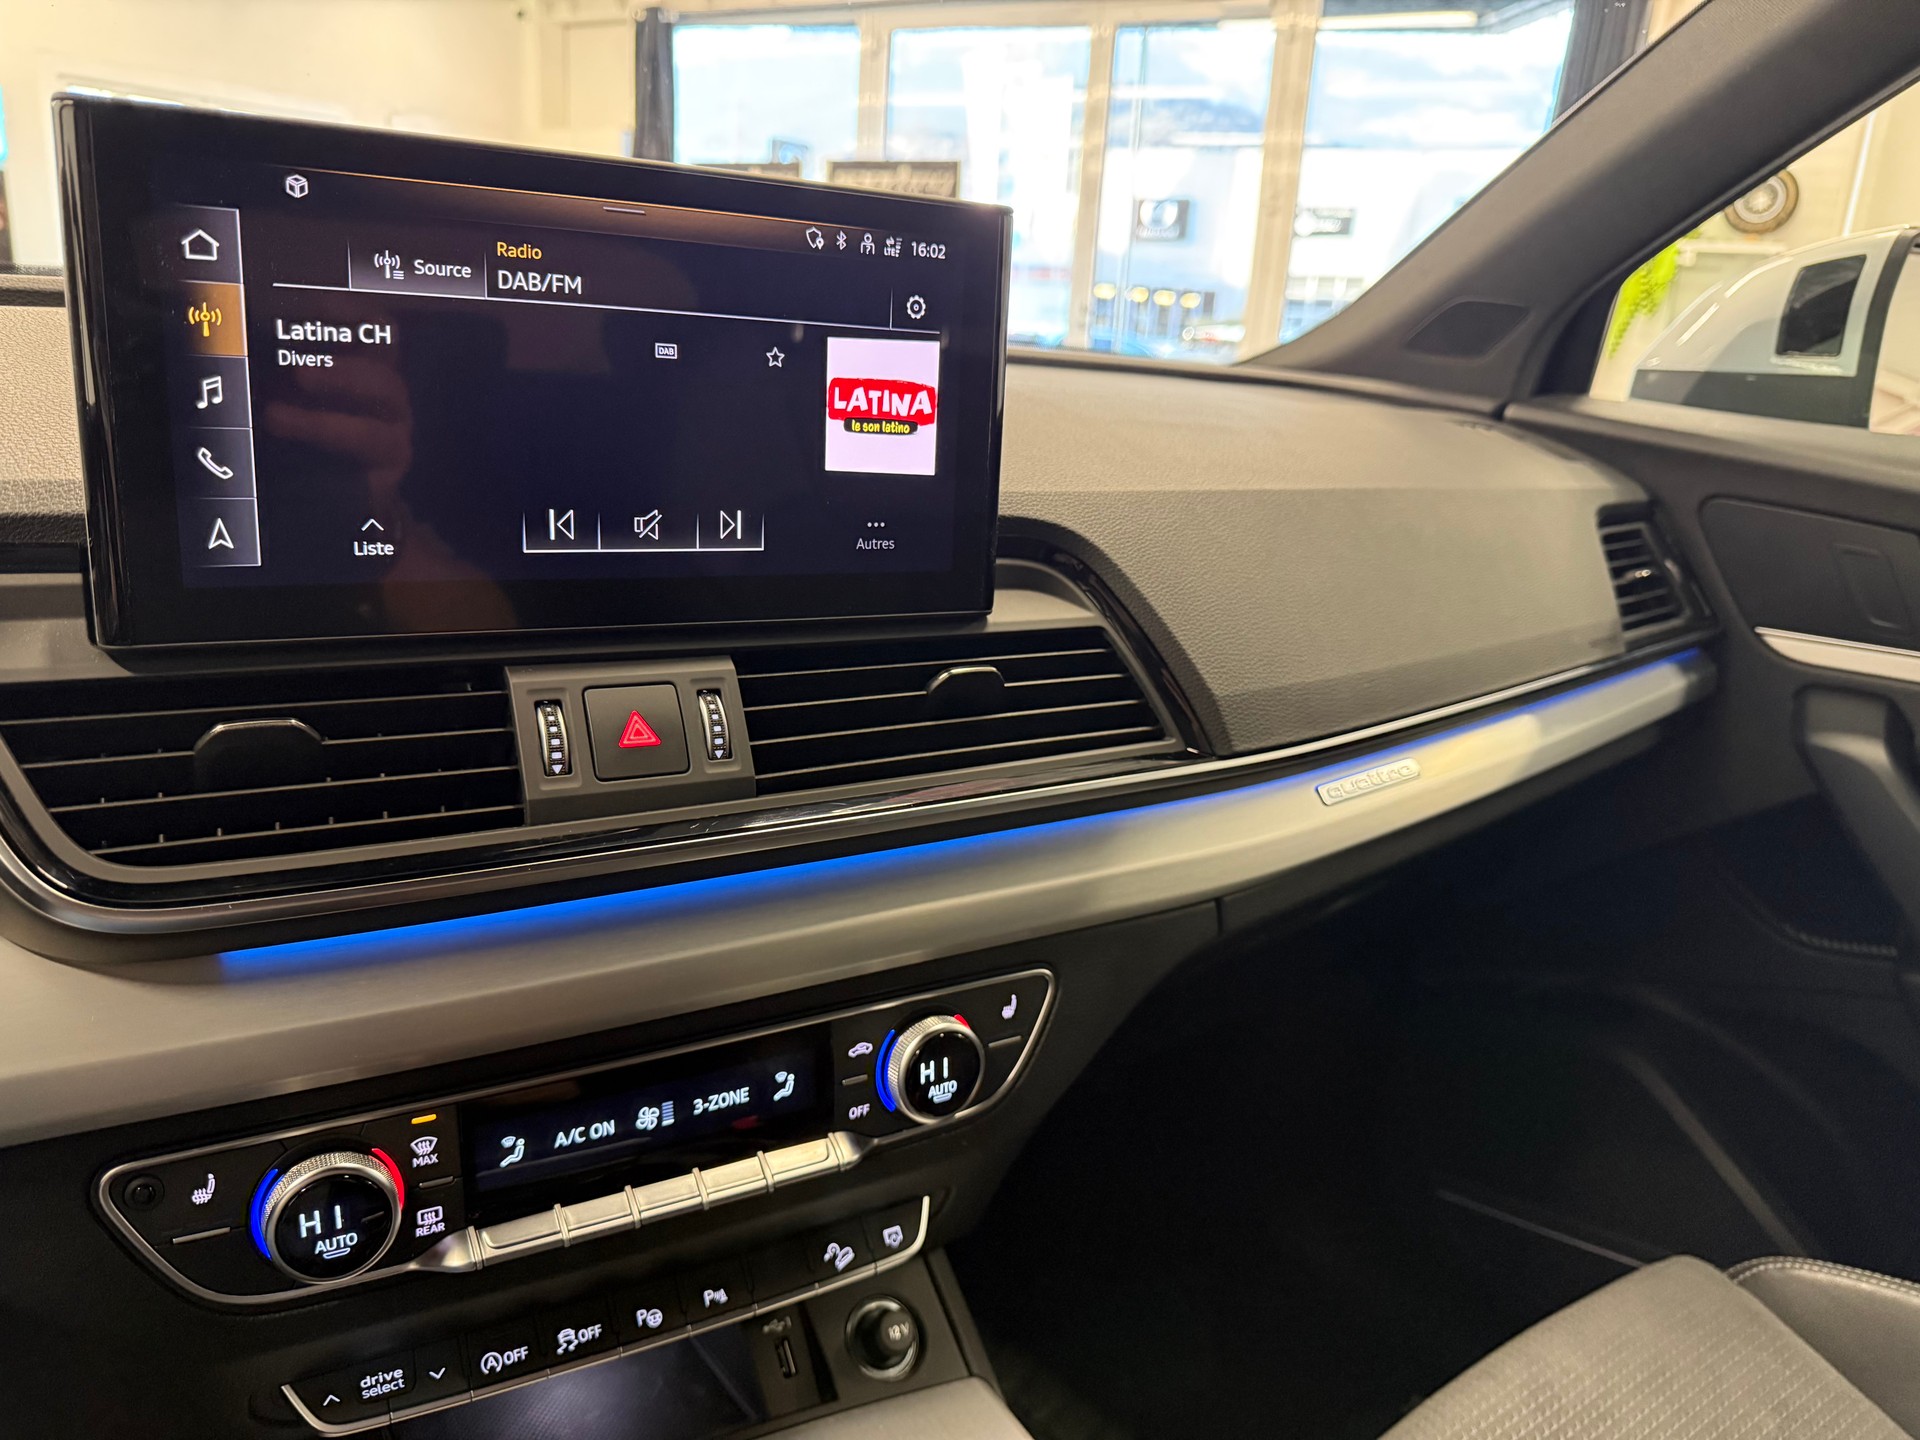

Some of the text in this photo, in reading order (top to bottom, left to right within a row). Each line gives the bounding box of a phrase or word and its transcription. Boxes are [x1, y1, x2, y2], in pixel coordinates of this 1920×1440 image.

[496, 241, 543, 260] Radio
[911, 241, 946, 260] 16:02
[413, 258, 472, 279] Source
[496, 270, 583, 295] DAB/FM
[275, 319, 393, 345] Latina CH
[277, 350, 334, 368] Divers
[658, 346, 675, 356] DAB
[833, 386, 933, 417] LATINA
[851, 419, 910, 434] le son latino
[353, 541, 395, 556] Liste
[855, 537, 896, 550] Autres
[1325, 765, 1412, 800] quattro
[928, 1080, 958, 1100] AUTO
[693, 1086, 751, 1116] 3-ZONE
[848, 1103, 871, 1121] OFF
[553, 1119, 616, 1149] A/C ON
[412, 1152, 439, 1169] MAX
[415, 1220, 446, 1239] REAR
[314, 1232, 359, 1255] AUTO
[577, 1323, 602, 1343] OFF
[503, 1346, 529, 1366] OFF
[360, 1367, 404, 1389] drive
[361, 1377, 406, 1400] select
